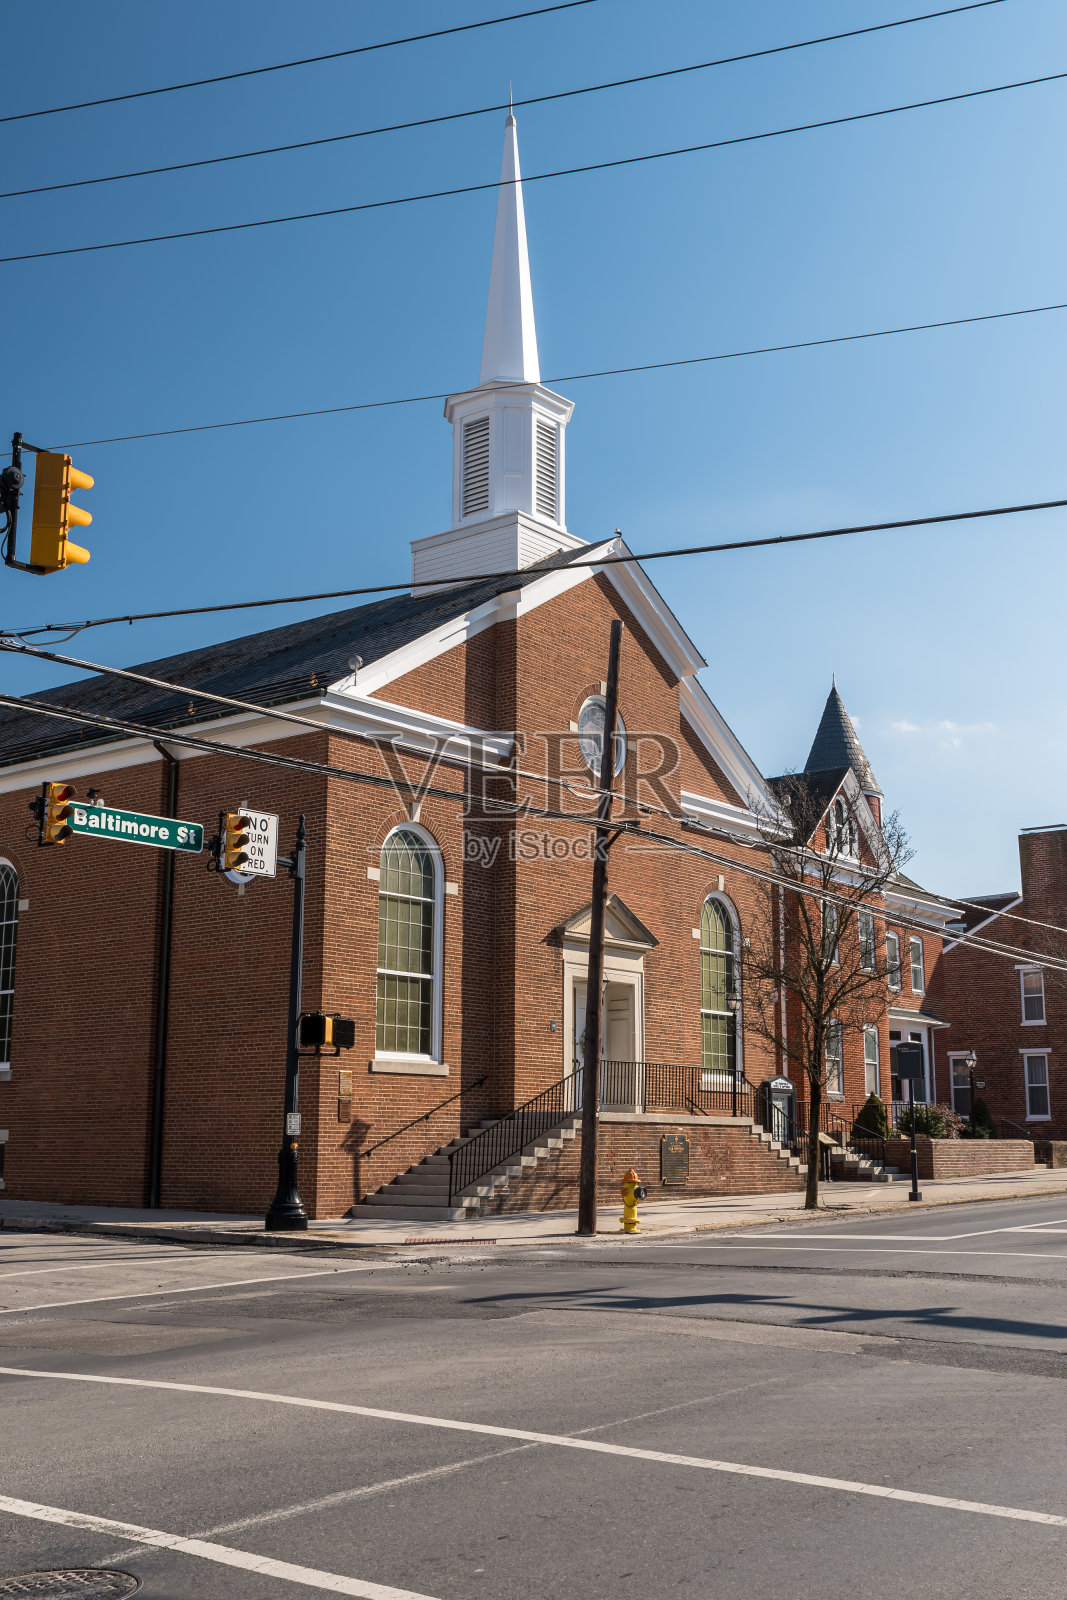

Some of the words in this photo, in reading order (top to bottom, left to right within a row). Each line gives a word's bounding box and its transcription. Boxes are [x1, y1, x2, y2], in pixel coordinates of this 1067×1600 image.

[73, 807, 170, 840] Baltimore
[177, 826, 196, 845] St
[248, 816, 268, 832] NO
[250, 845, 264, 857] ON
[248, 858, 265, 870] RED
